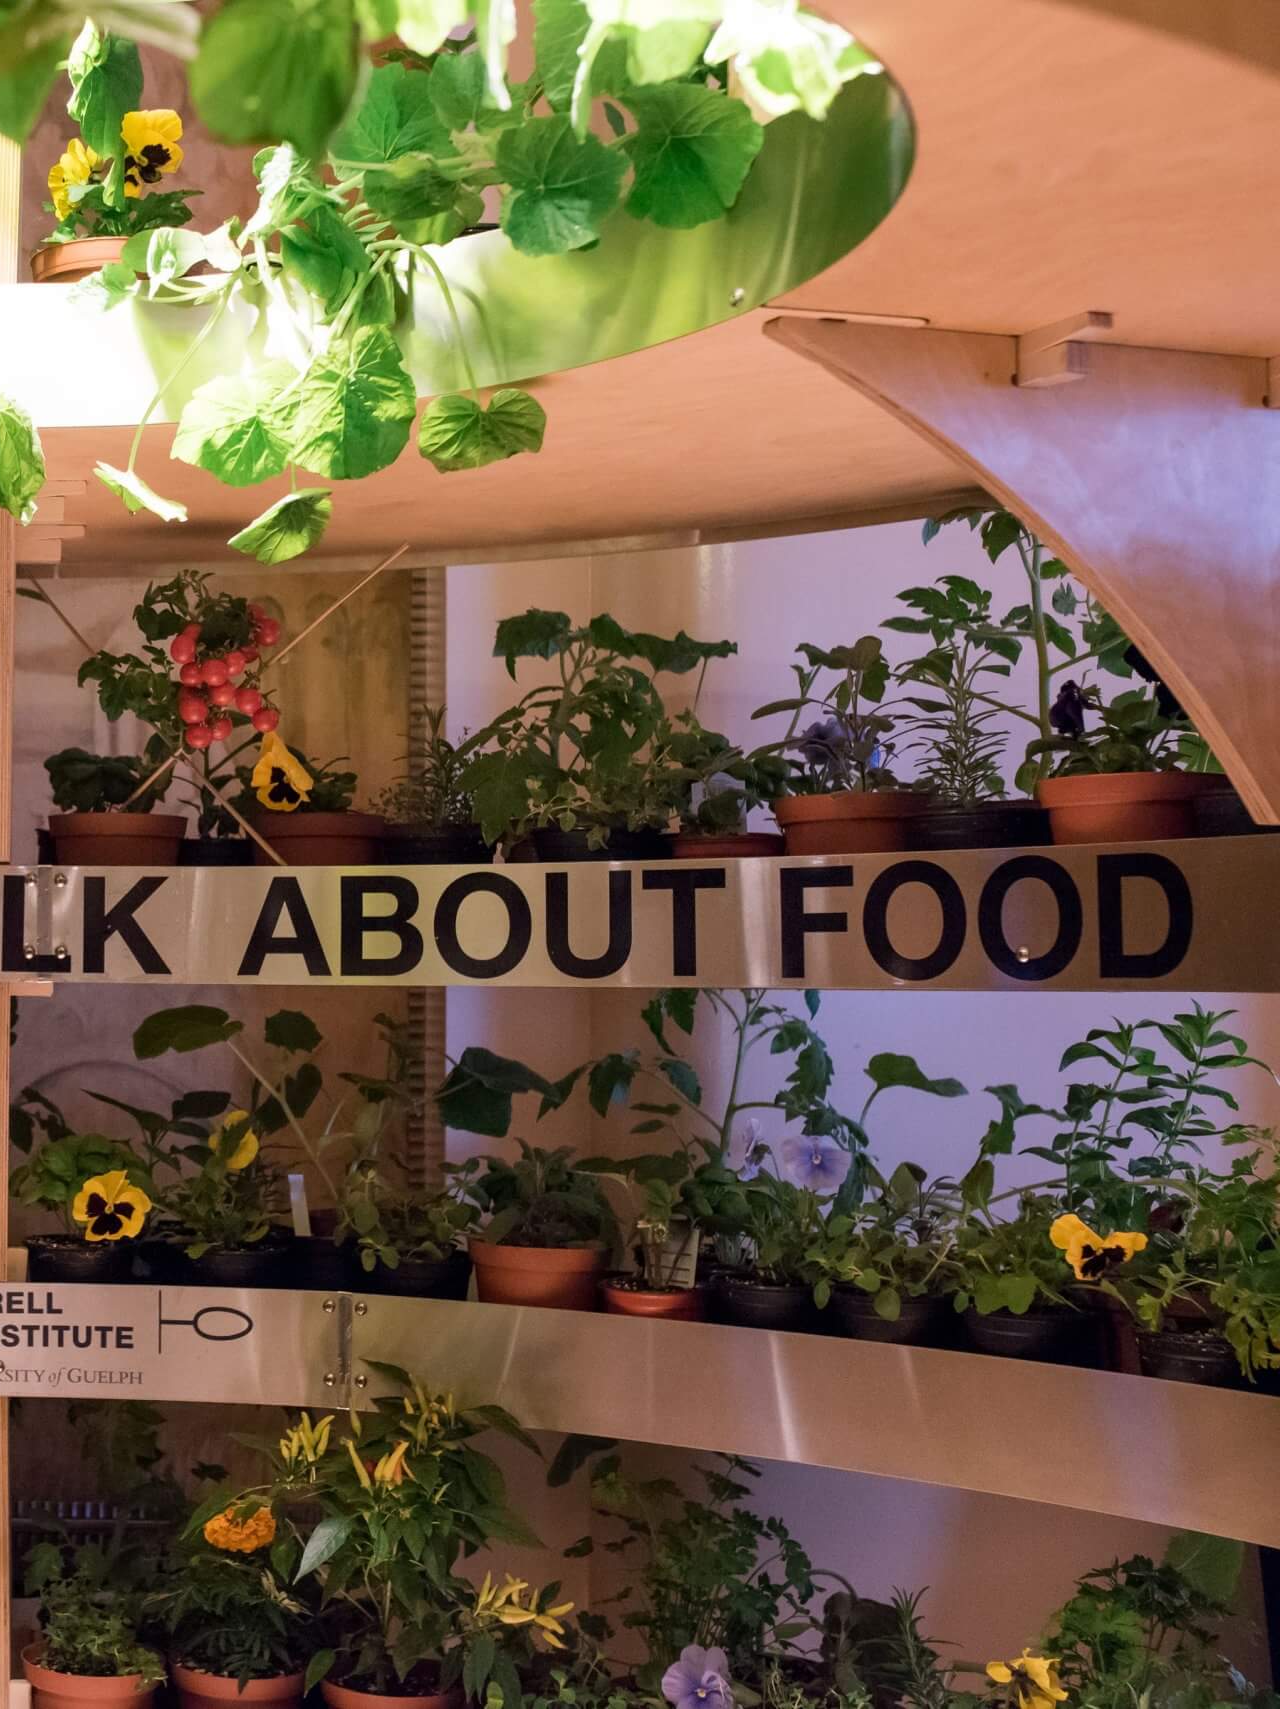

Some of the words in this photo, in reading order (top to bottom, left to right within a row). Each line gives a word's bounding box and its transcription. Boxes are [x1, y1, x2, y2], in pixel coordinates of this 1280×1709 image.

[237, 868, 726, 980] ABOUT
[779, 852, 1194, 981] FOOD
[48, 1367, 67, 1388] of
[67, 1367, 143, 1385] GUELPH
